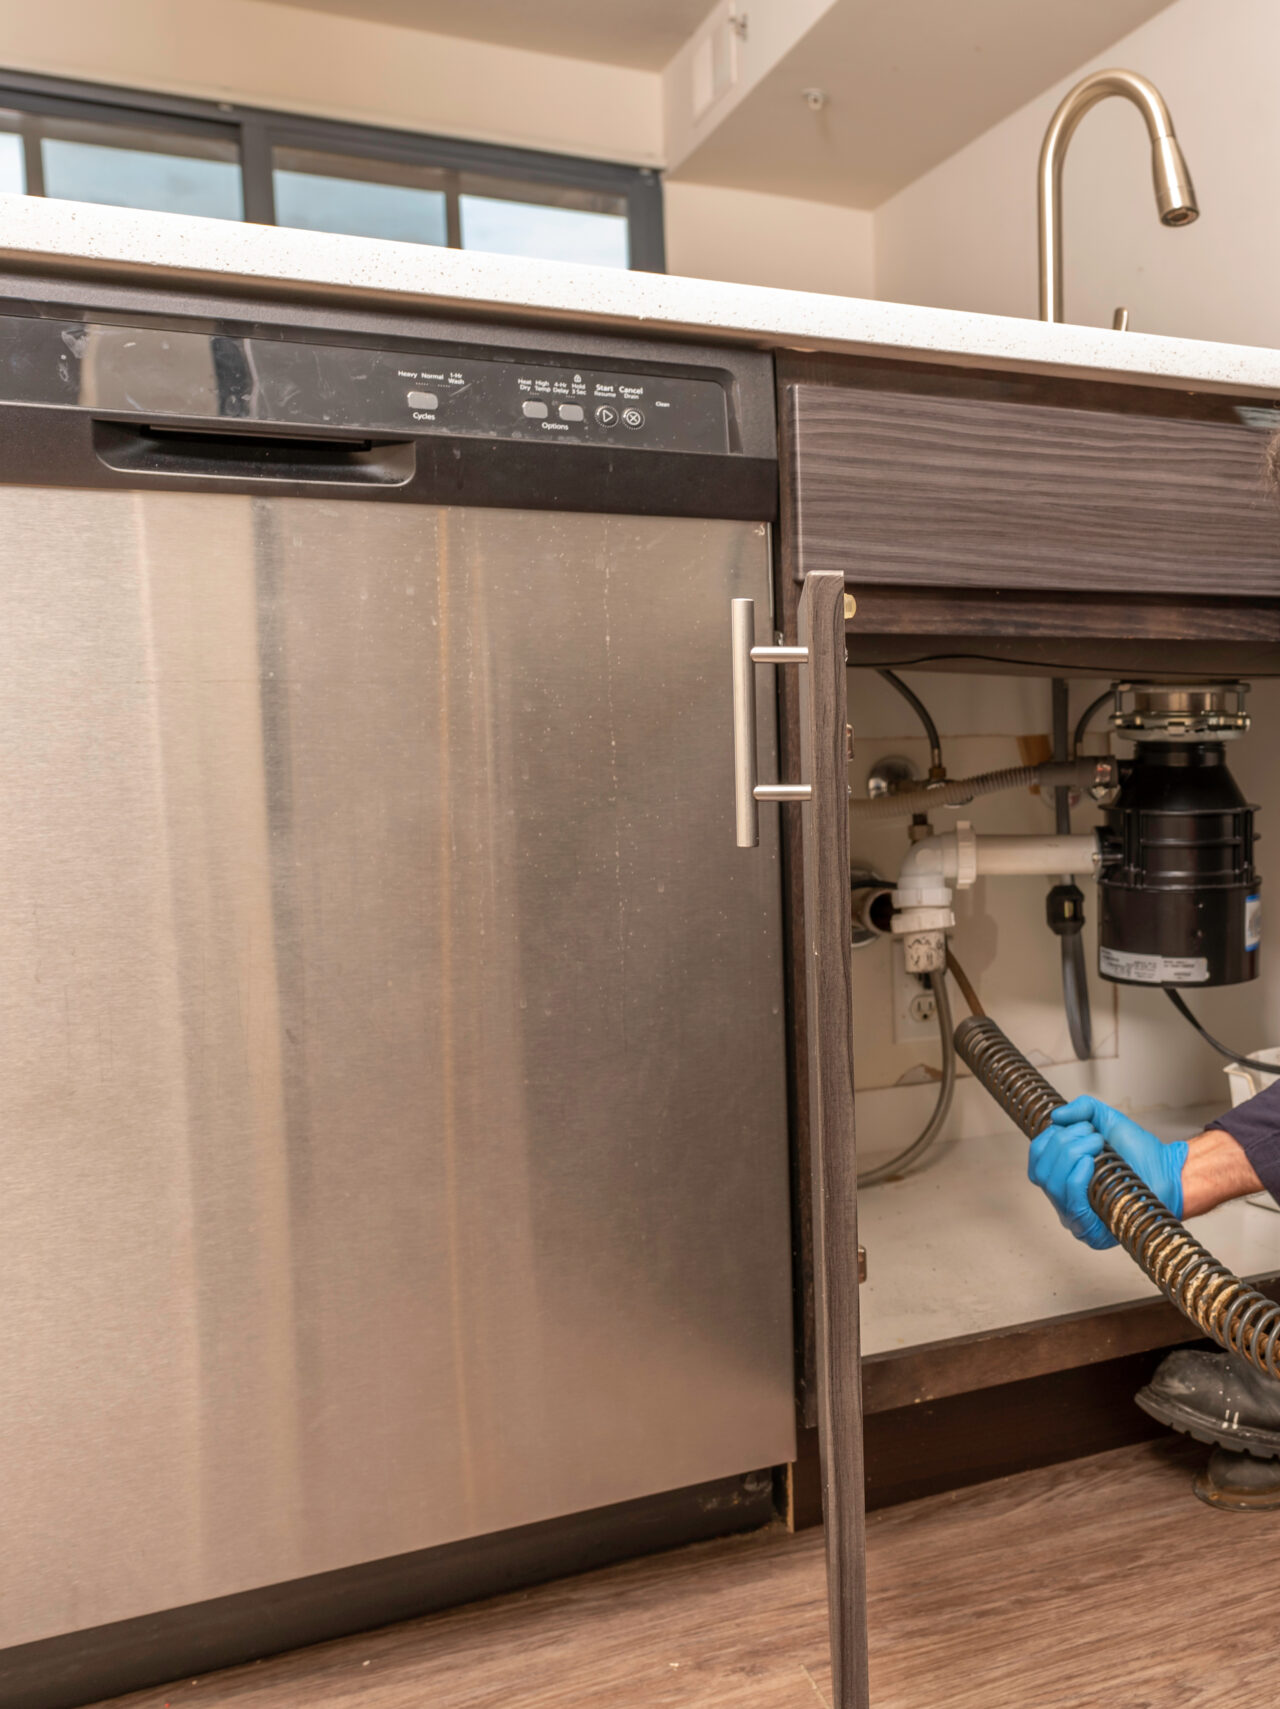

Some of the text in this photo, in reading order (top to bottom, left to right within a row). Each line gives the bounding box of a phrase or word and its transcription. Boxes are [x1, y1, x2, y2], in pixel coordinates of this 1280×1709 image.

[398, 370, 418, 379] Heavy
[518, 378, 532, 386] Heat
[535, 380, 549, 388] High
[553, 387, 569, 395] Delay
[596, 384, 614, 392] Start
[619, 386, 643, 394] Cancel
[412, 412, 436, 420] Cycles
[542, 422, 569, 430] Options
